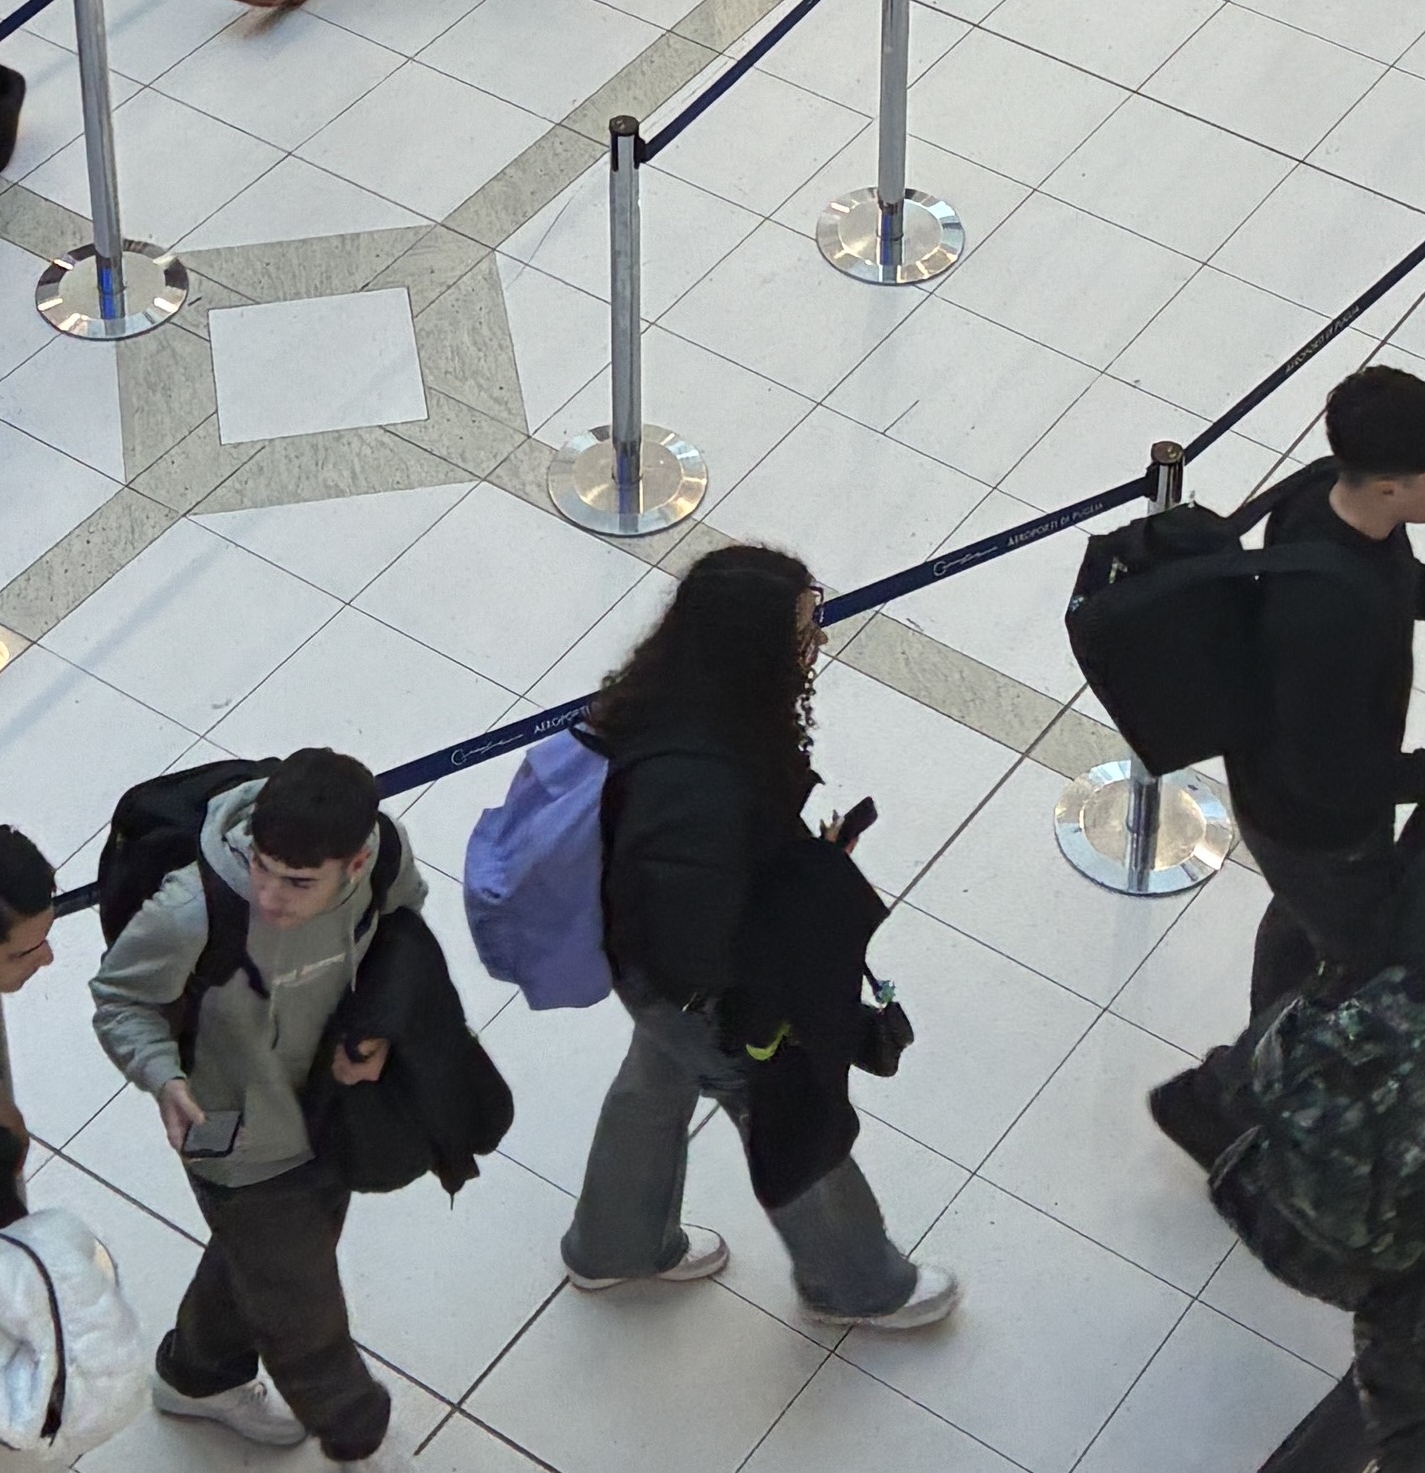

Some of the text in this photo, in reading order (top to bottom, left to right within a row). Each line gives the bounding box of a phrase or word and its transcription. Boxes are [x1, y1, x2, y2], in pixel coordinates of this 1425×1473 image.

[1007, 502, 1104, 547] AEROPORTI DI PUGLIA
